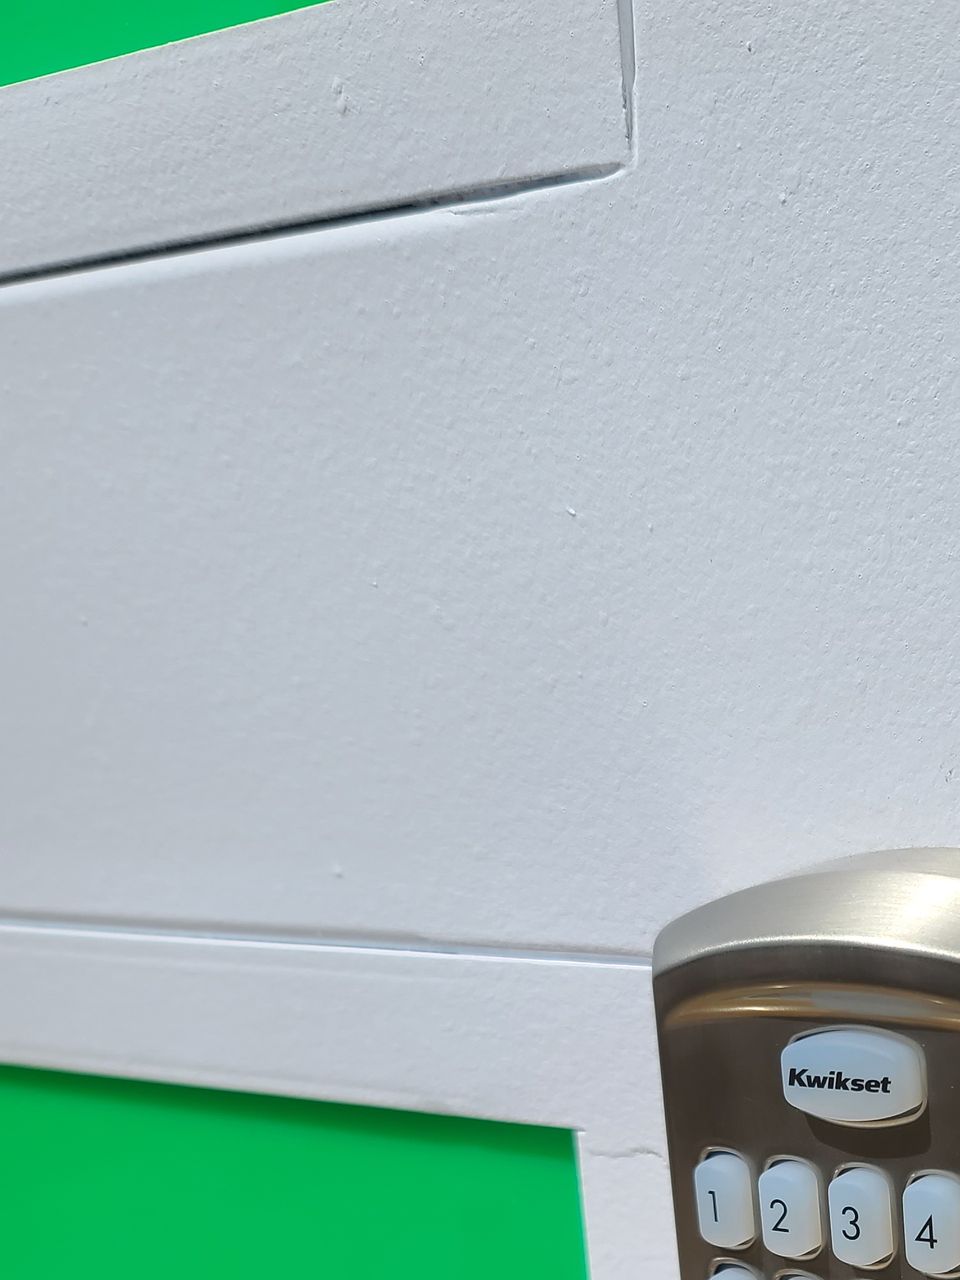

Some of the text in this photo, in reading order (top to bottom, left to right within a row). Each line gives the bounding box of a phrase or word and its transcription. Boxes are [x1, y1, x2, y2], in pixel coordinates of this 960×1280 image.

[789, 1068, 891, 1093] Kwikset
[708, 1191, 718, 1222] 1
[770, 1199, 789, 1232] 2
[842, 1207, 860, 1240] 3
[915, 1215, 937, 1249] 4
